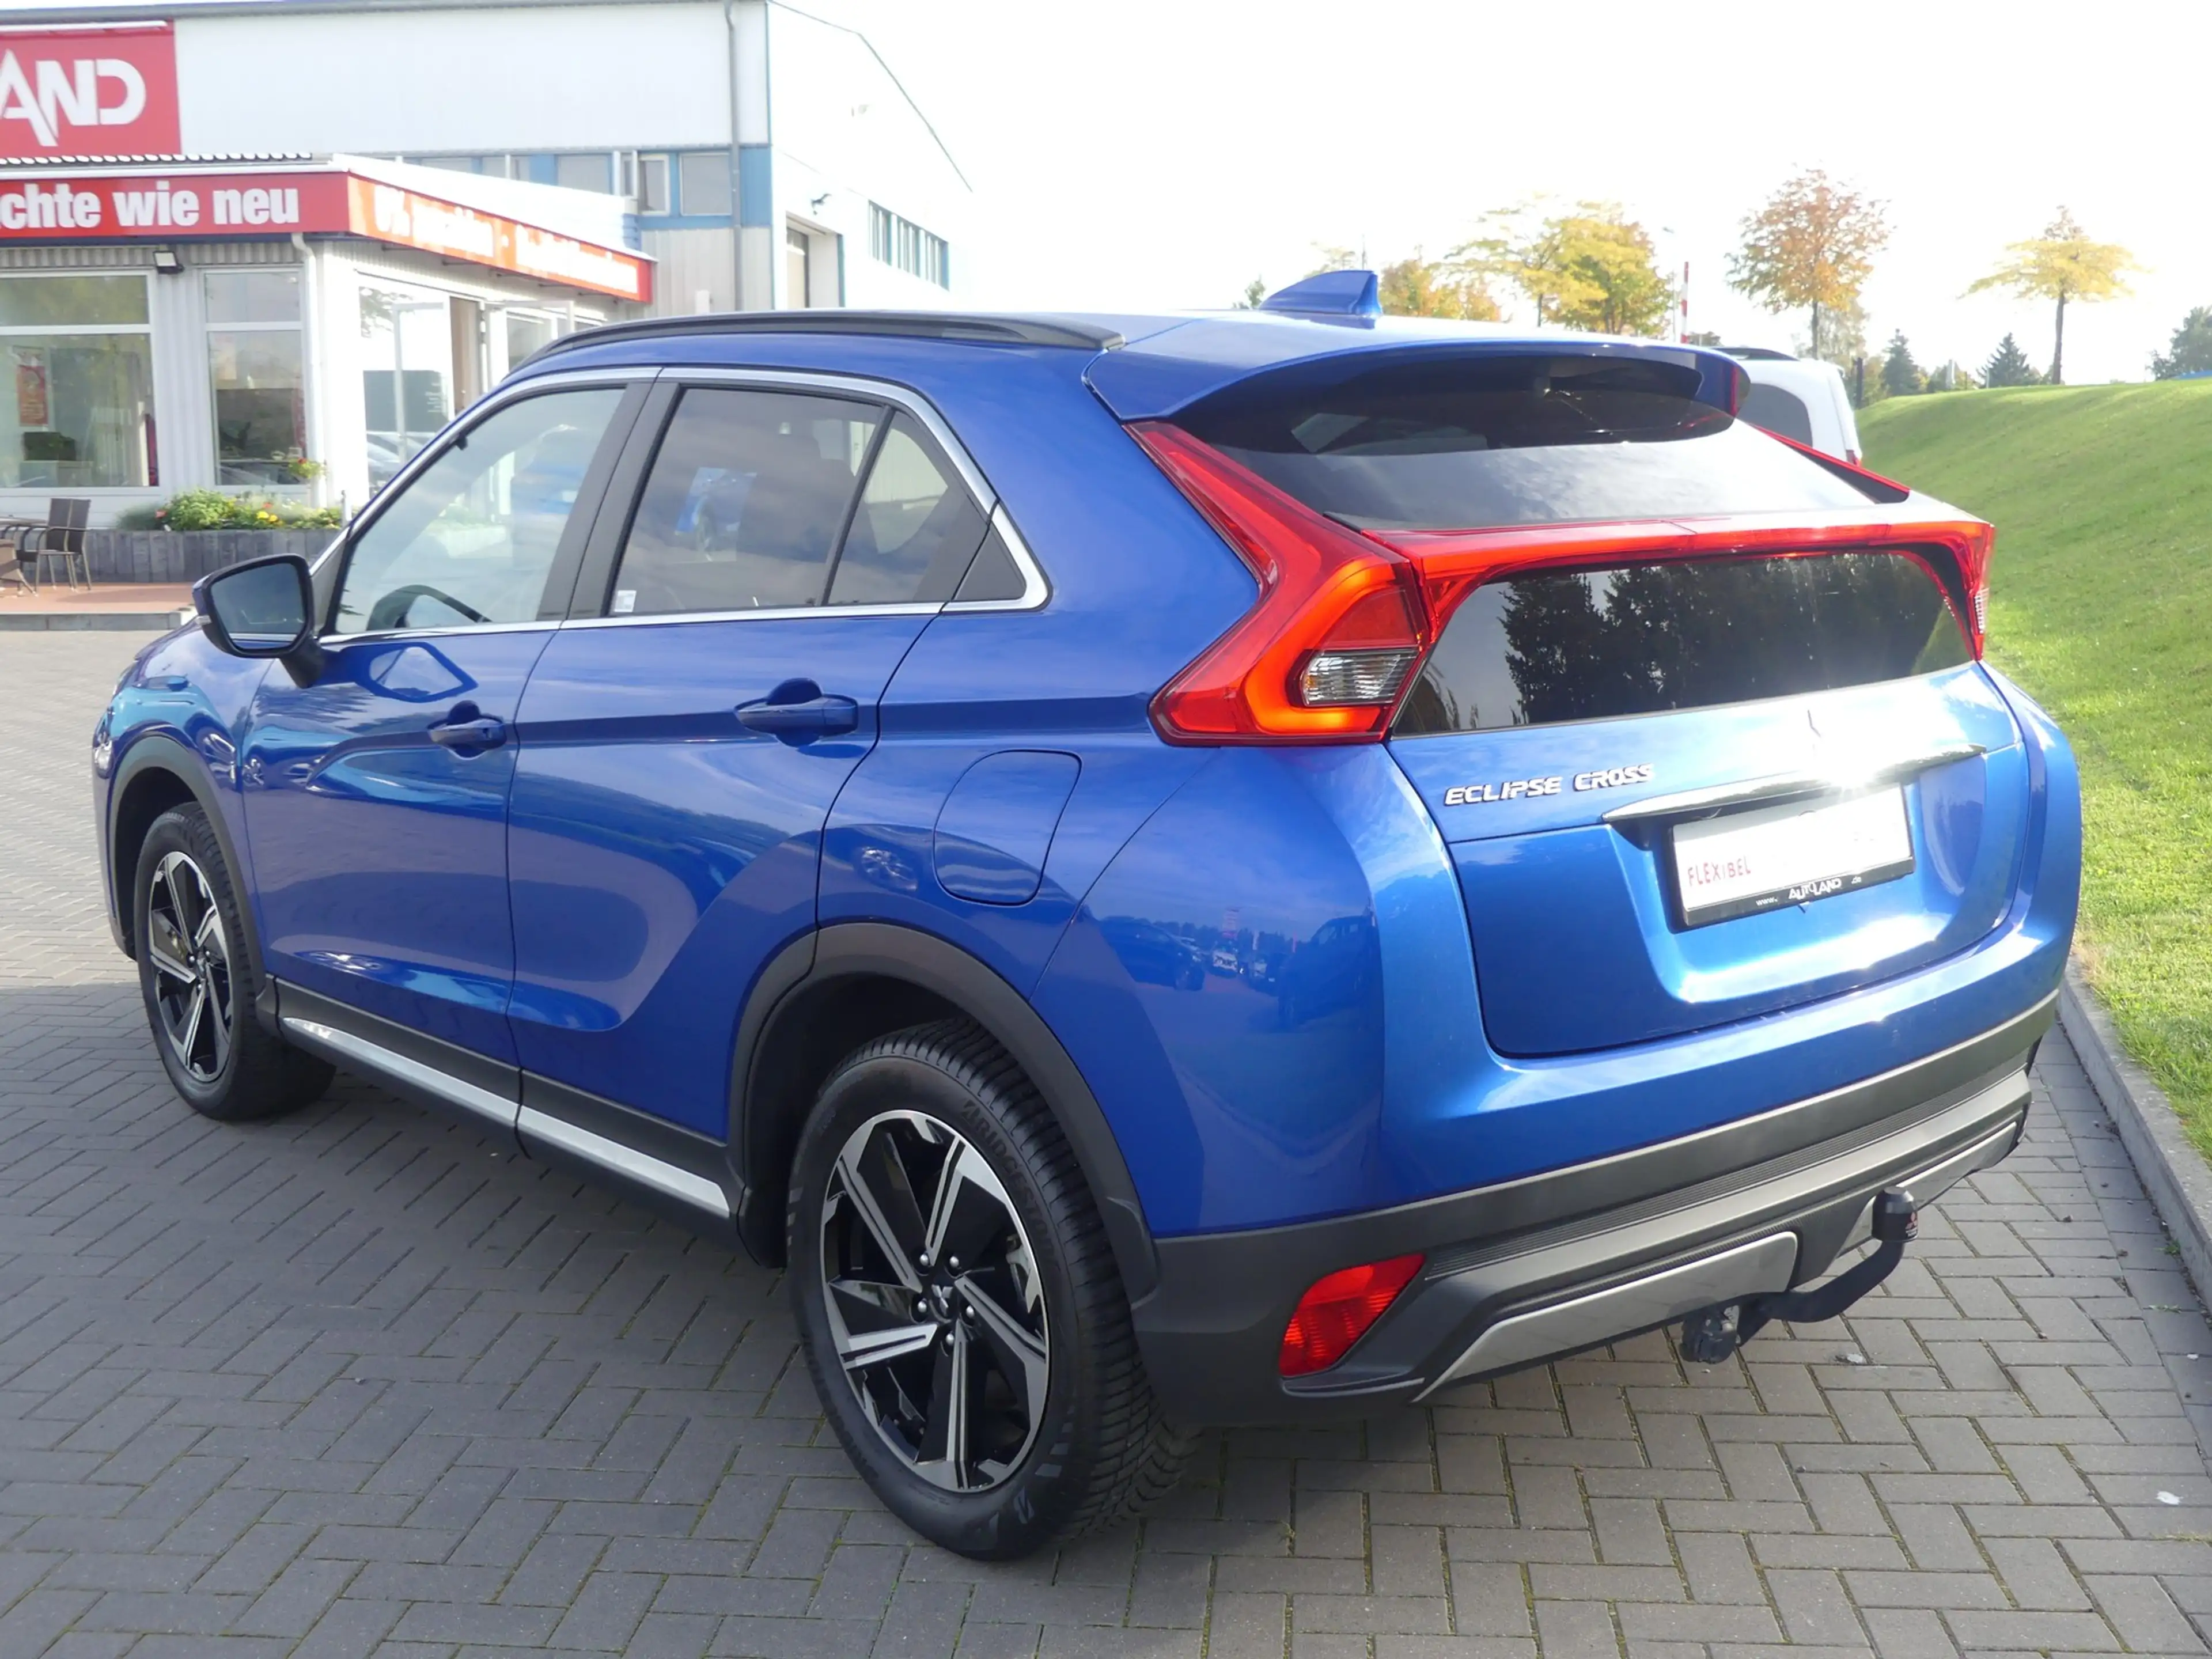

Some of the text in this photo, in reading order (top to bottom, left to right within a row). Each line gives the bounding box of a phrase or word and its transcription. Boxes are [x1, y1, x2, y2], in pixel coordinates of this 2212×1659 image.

[0, 48, 146, 147] AND
[0, 181, 299, 229] chte wie neu
[1444, 763, 1654, 806] ECLIPSE CROSS
[1687, 855, 1751, 887] FLEXIBEL
[1756, 875, 1862, 907] www. AUTOLAND .de
